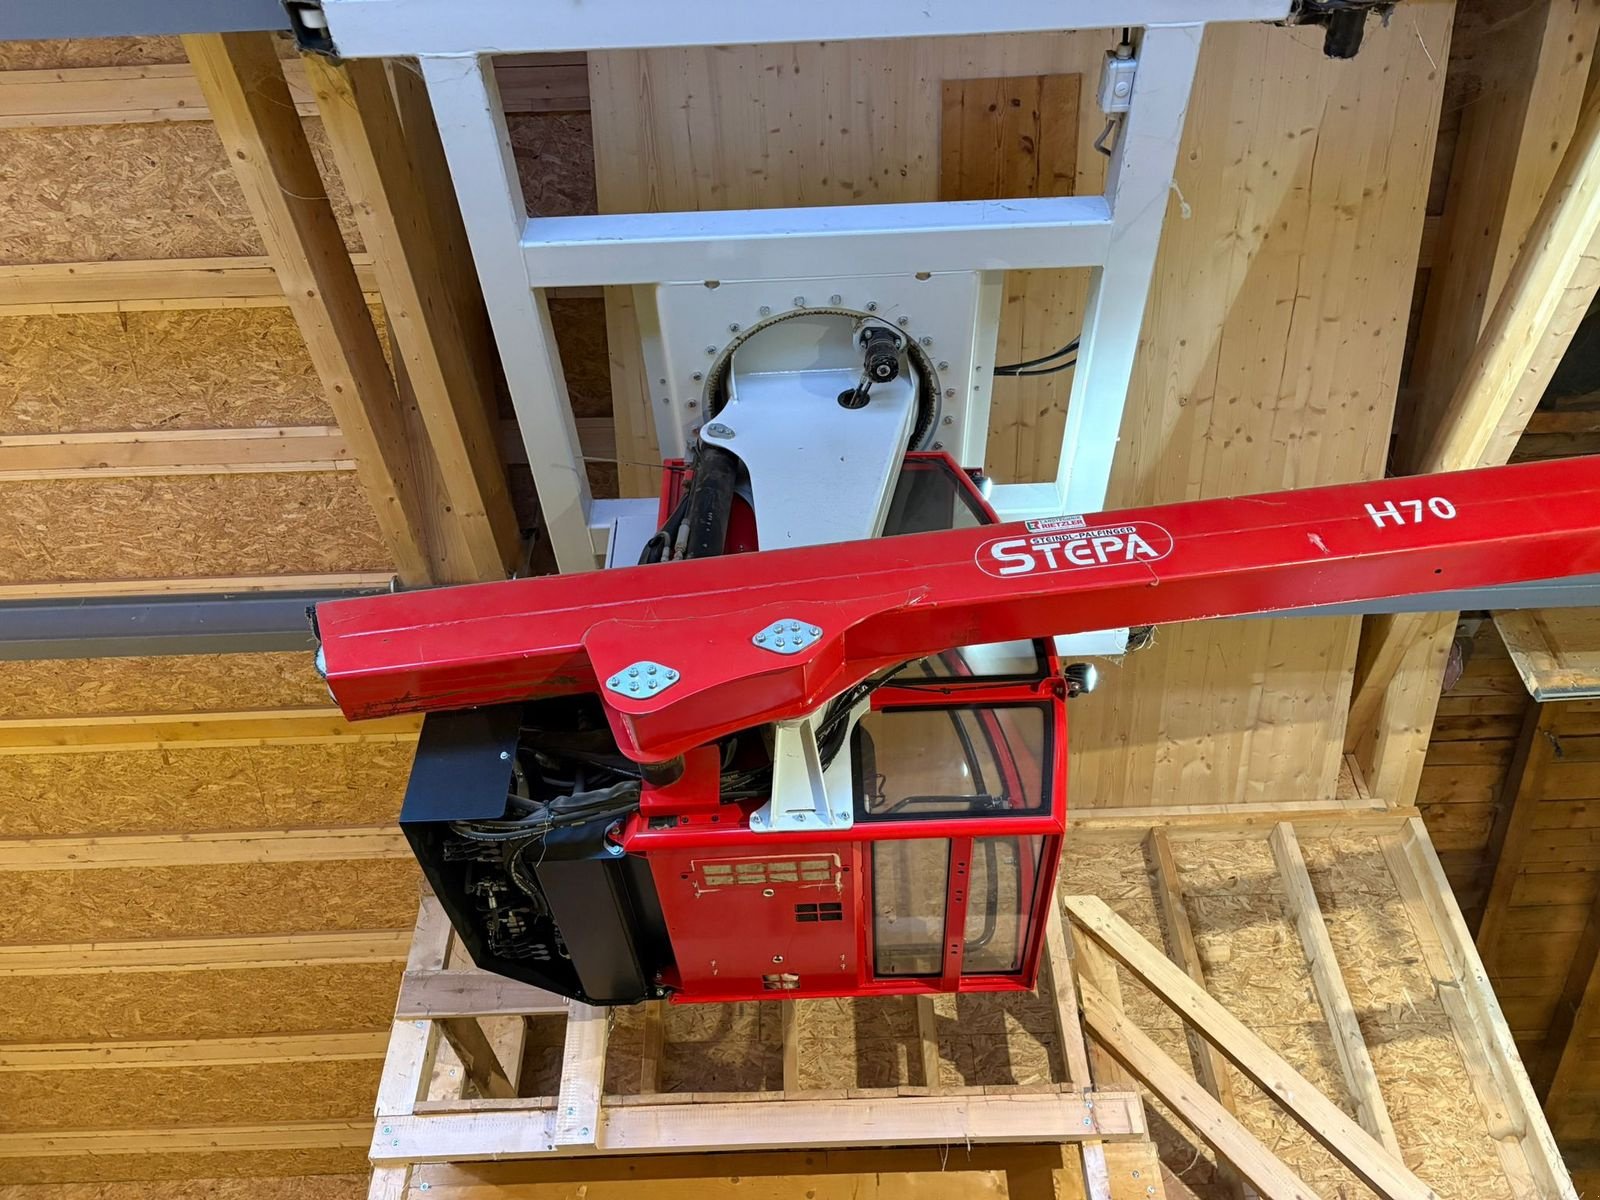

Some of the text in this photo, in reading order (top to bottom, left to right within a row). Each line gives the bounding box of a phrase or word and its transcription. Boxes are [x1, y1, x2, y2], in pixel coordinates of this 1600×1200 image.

[1363, 496, 1457, 528] H70
[1032, 527, 1134, 544] STEINDL-PALFINGER
[1041, 520, 1083, 529] RIETZLER
[990, 533, 1159, 575] STEPA
